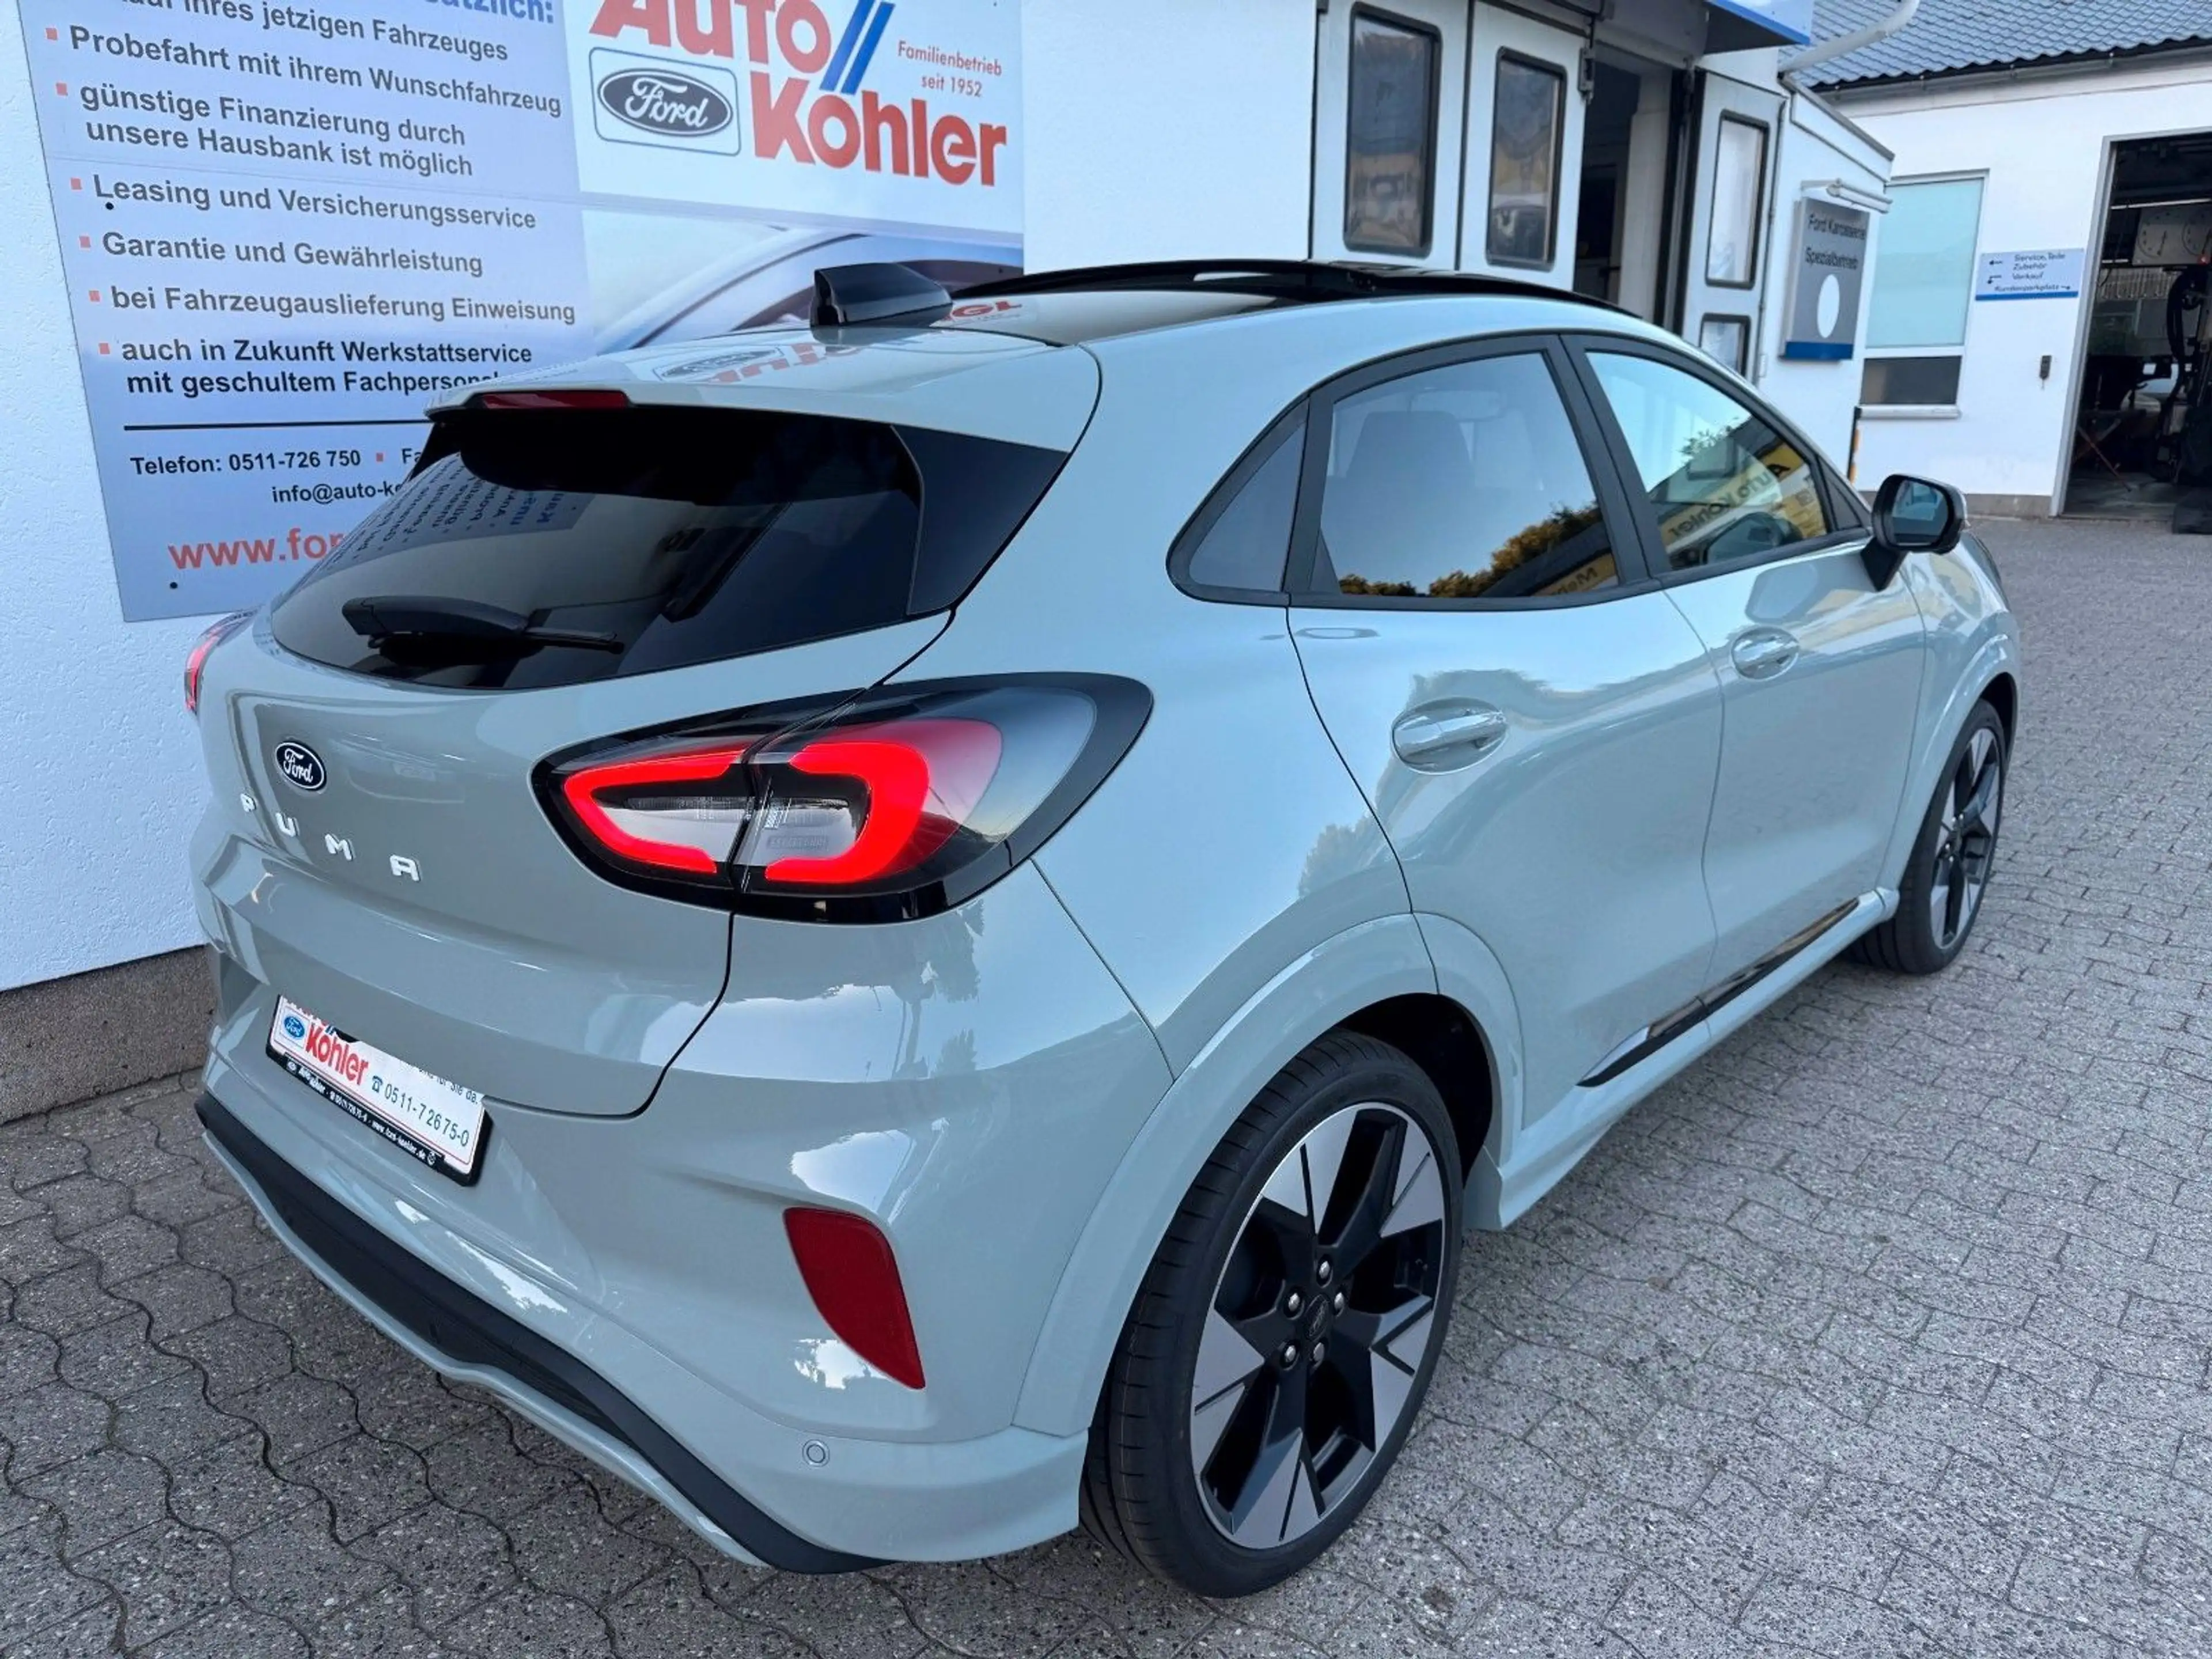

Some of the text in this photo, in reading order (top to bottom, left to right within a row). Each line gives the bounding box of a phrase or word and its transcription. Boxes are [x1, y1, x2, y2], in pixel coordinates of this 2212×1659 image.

[263, 2, 364, 38] jetzigen
[372, 19, 508, 61] Fahrzeuges
[70, 25, 562, 118] Probefahrt mit ihrem Wunschfahrzeug
[897, 40, 1002, 76] Familienbetrieb
[625, 77, 709, 128] Ford
[921, 73, 983, 98] seit 1952
[80, 84, 465, 146] günstige Finanzierung durch
[86, 122, 473, 177] unsere Hausbank ist möglich
[93, 174, 536, 229] Leasing und Versicherungsservice
[103, 232, 483, 277] Garantie und Gewährleistung
[111, 286, 575, 325] bei Fahrzeugauslieferung Einweisung
[122, 339, 532, 363] auch in Zukunft Werkstattservice
[127, 372, 172, 393] mit
[181, 372, 336, 398] geschultem
[130, 457, 222, 475] Telefon:
[229, 452, 321, 471] 0511-726
[329, 449, 361, 467] 750
[283, 748, 314, 783] Ford
[240, 792, 422, 882] PUMA
